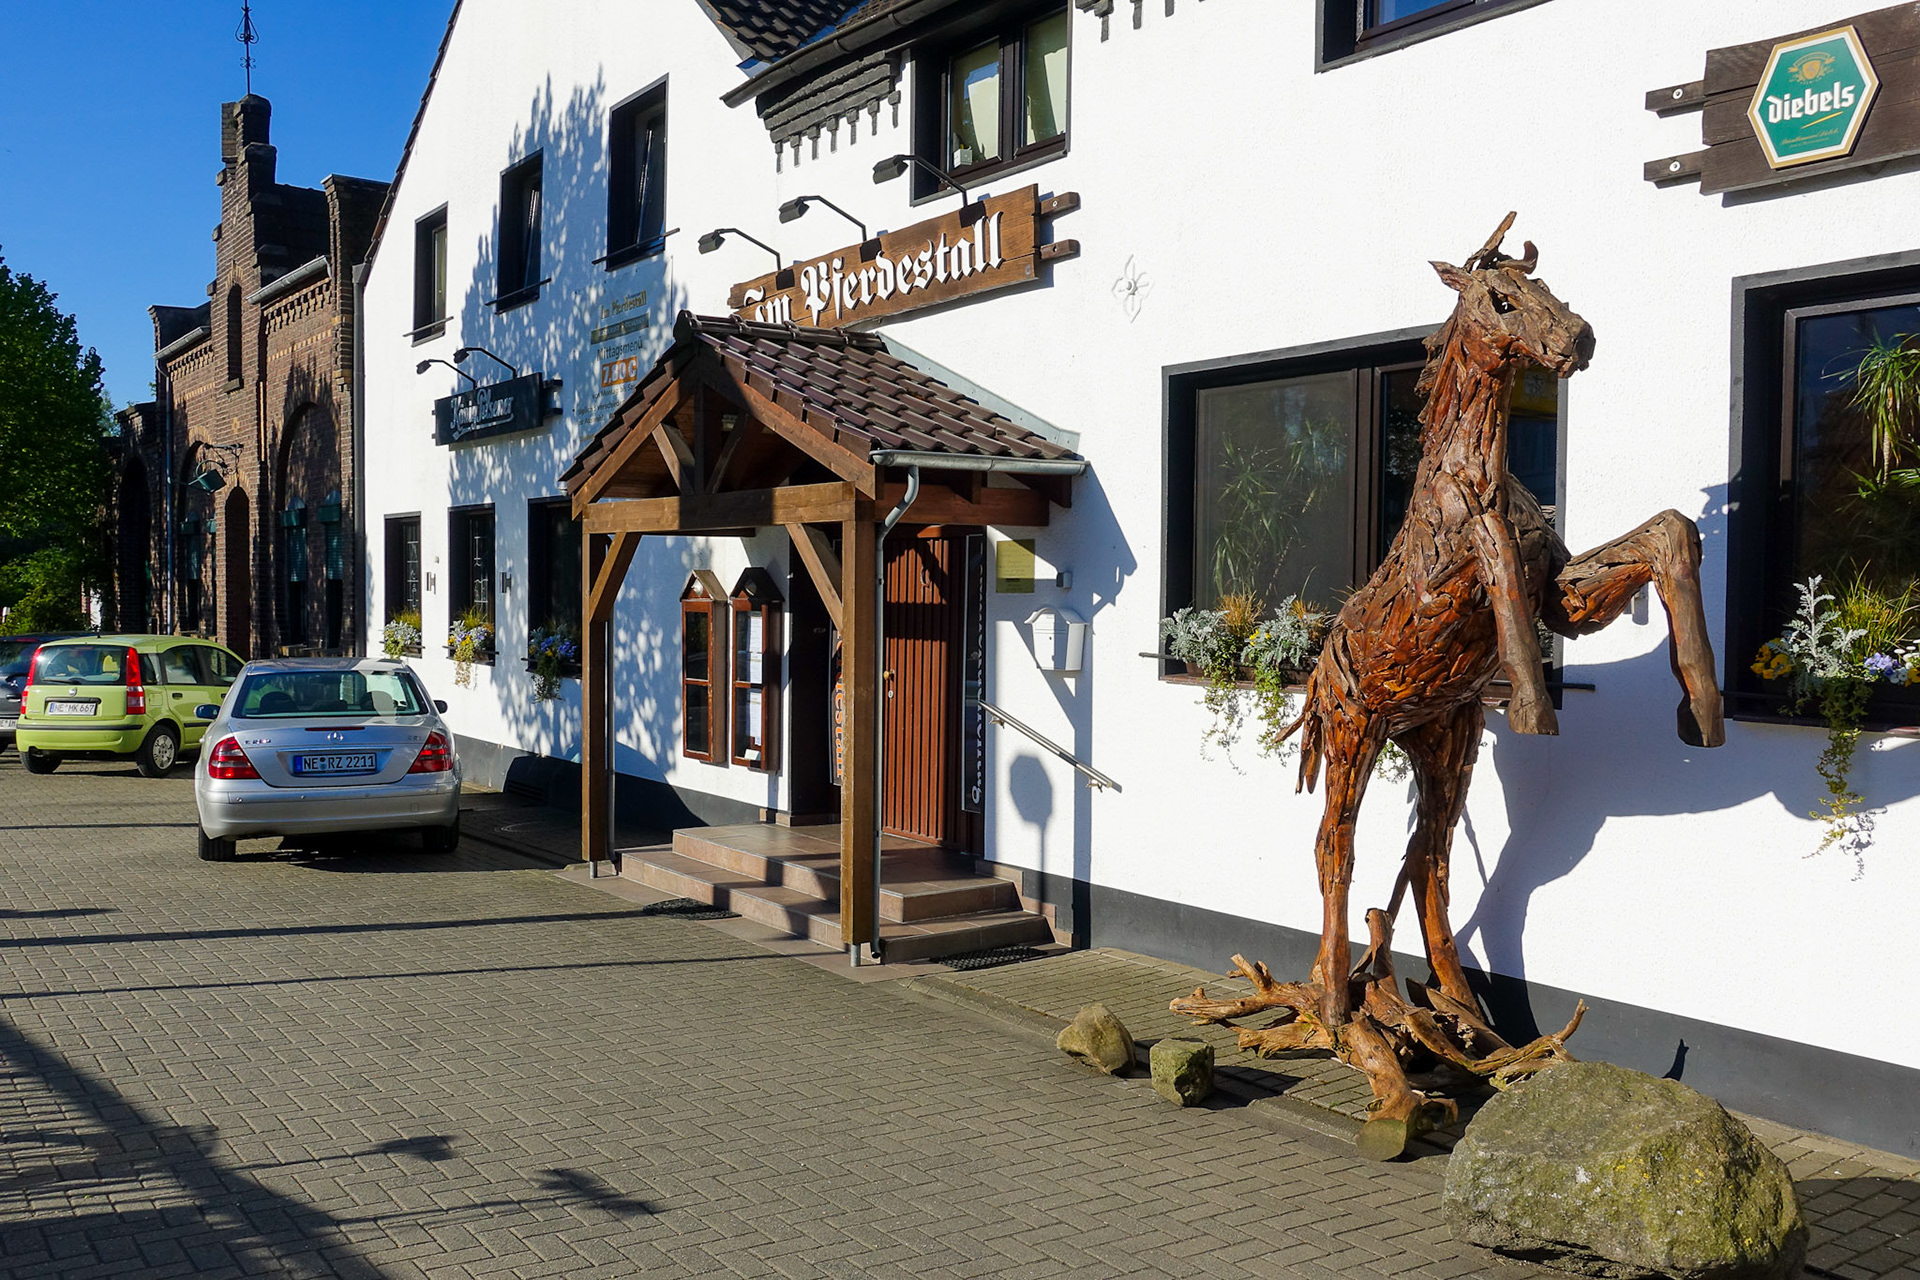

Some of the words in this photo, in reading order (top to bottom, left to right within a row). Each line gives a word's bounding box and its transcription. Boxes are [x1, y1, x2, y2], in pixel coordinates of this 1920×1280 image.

[800, 211, 1006, 326] Pferdestall
[597, 336, 644, 361] Mittagsmenü
[450, 396, 479, 430] König
[477, 389, 514, 421] Pilsener
[80, 704, 95, 712] 667
[304, 756, 318, 769] NE
[327, 755, 342, 768] RZ
[346, 755, 375, 768] 2211
